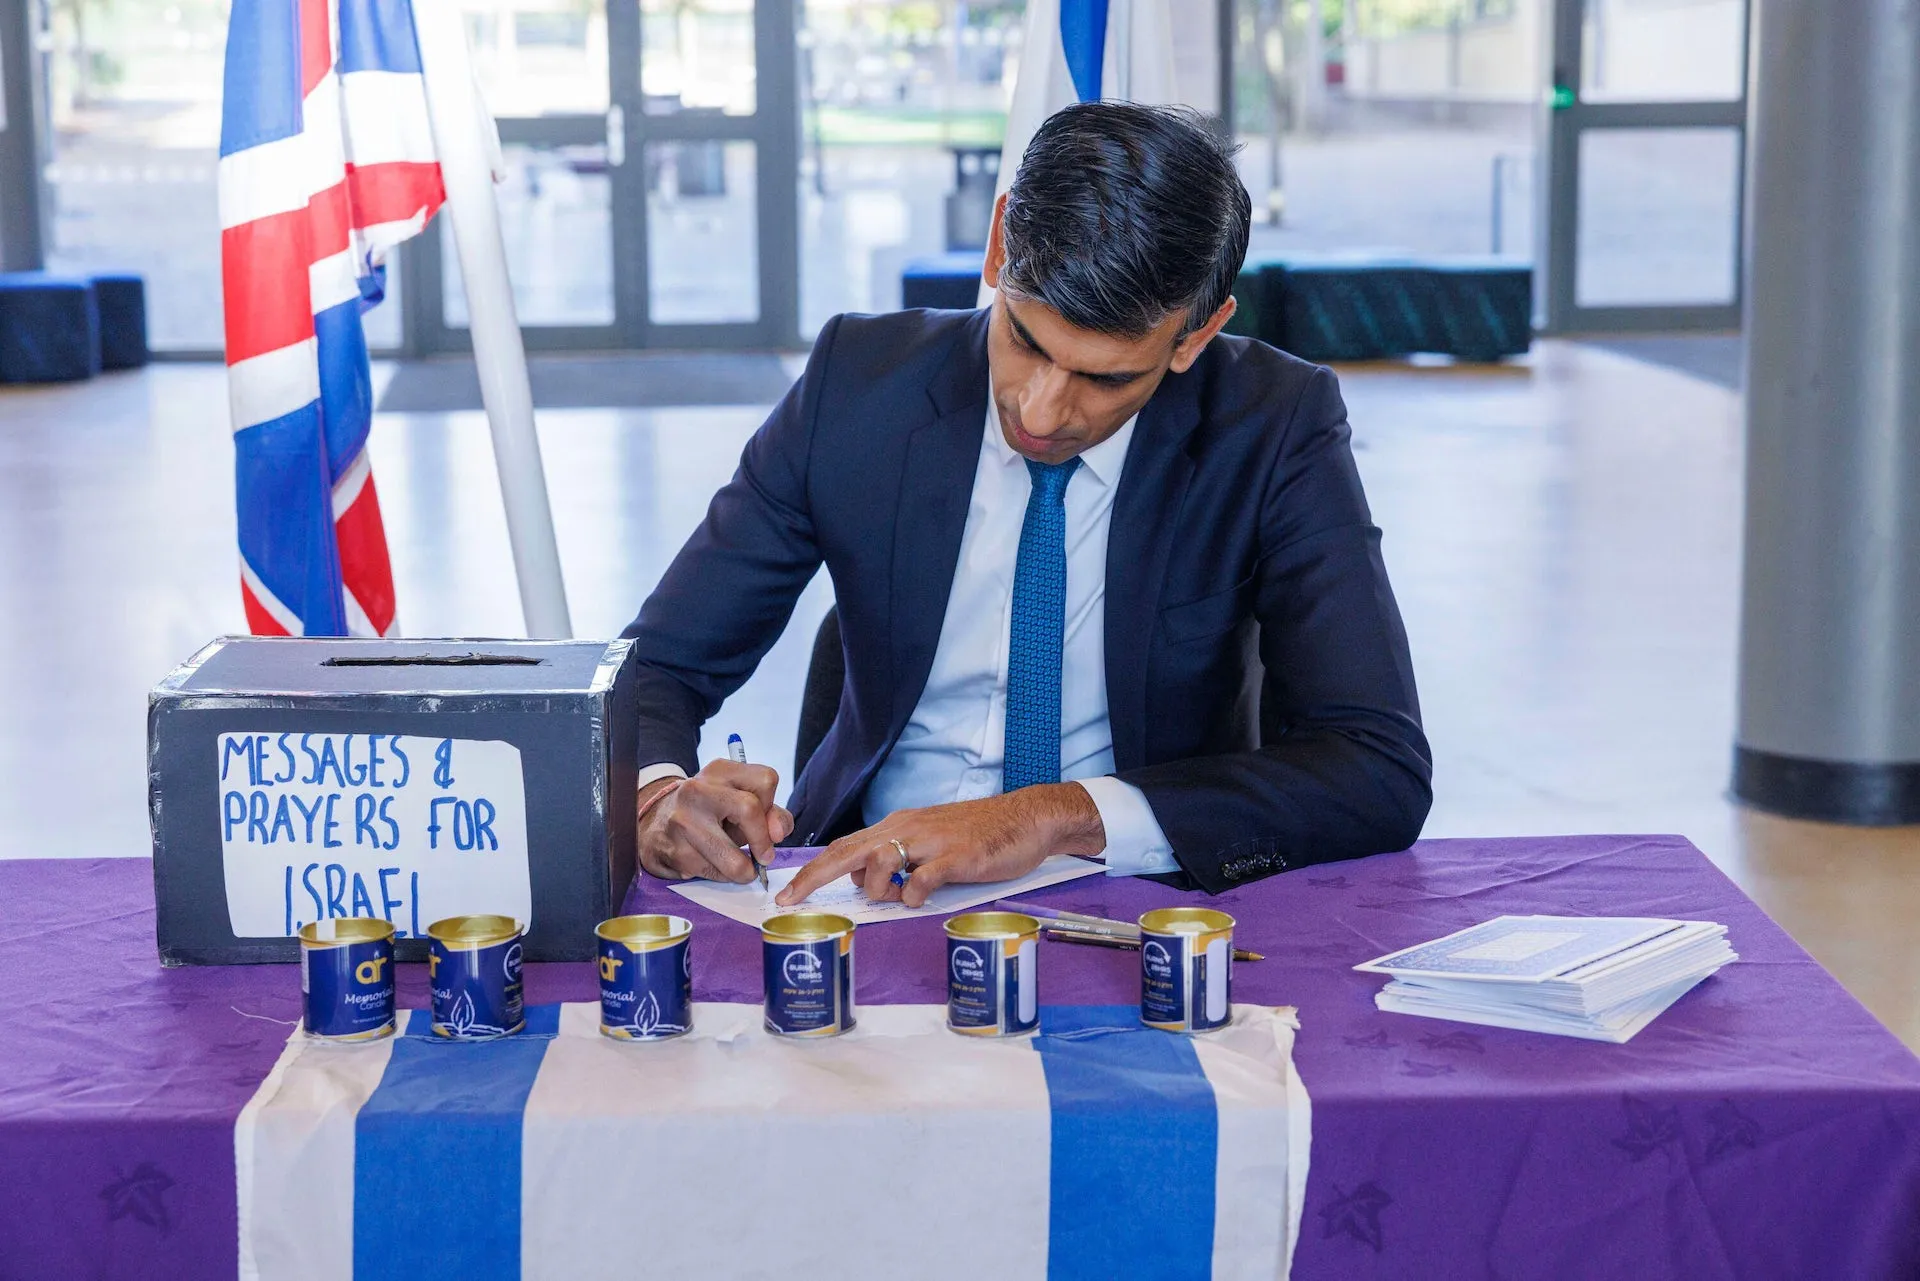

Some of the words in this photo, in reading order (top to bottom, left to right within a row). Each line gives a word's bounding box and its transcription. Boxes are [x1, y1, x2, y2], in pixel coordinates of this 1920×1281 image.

[221, 733, 410, 789] MESSAGES
[433, 737, 455, 789] &
[223, 790, 400, 851] PRAYERS
[427, 796, 499, 851] FOR
